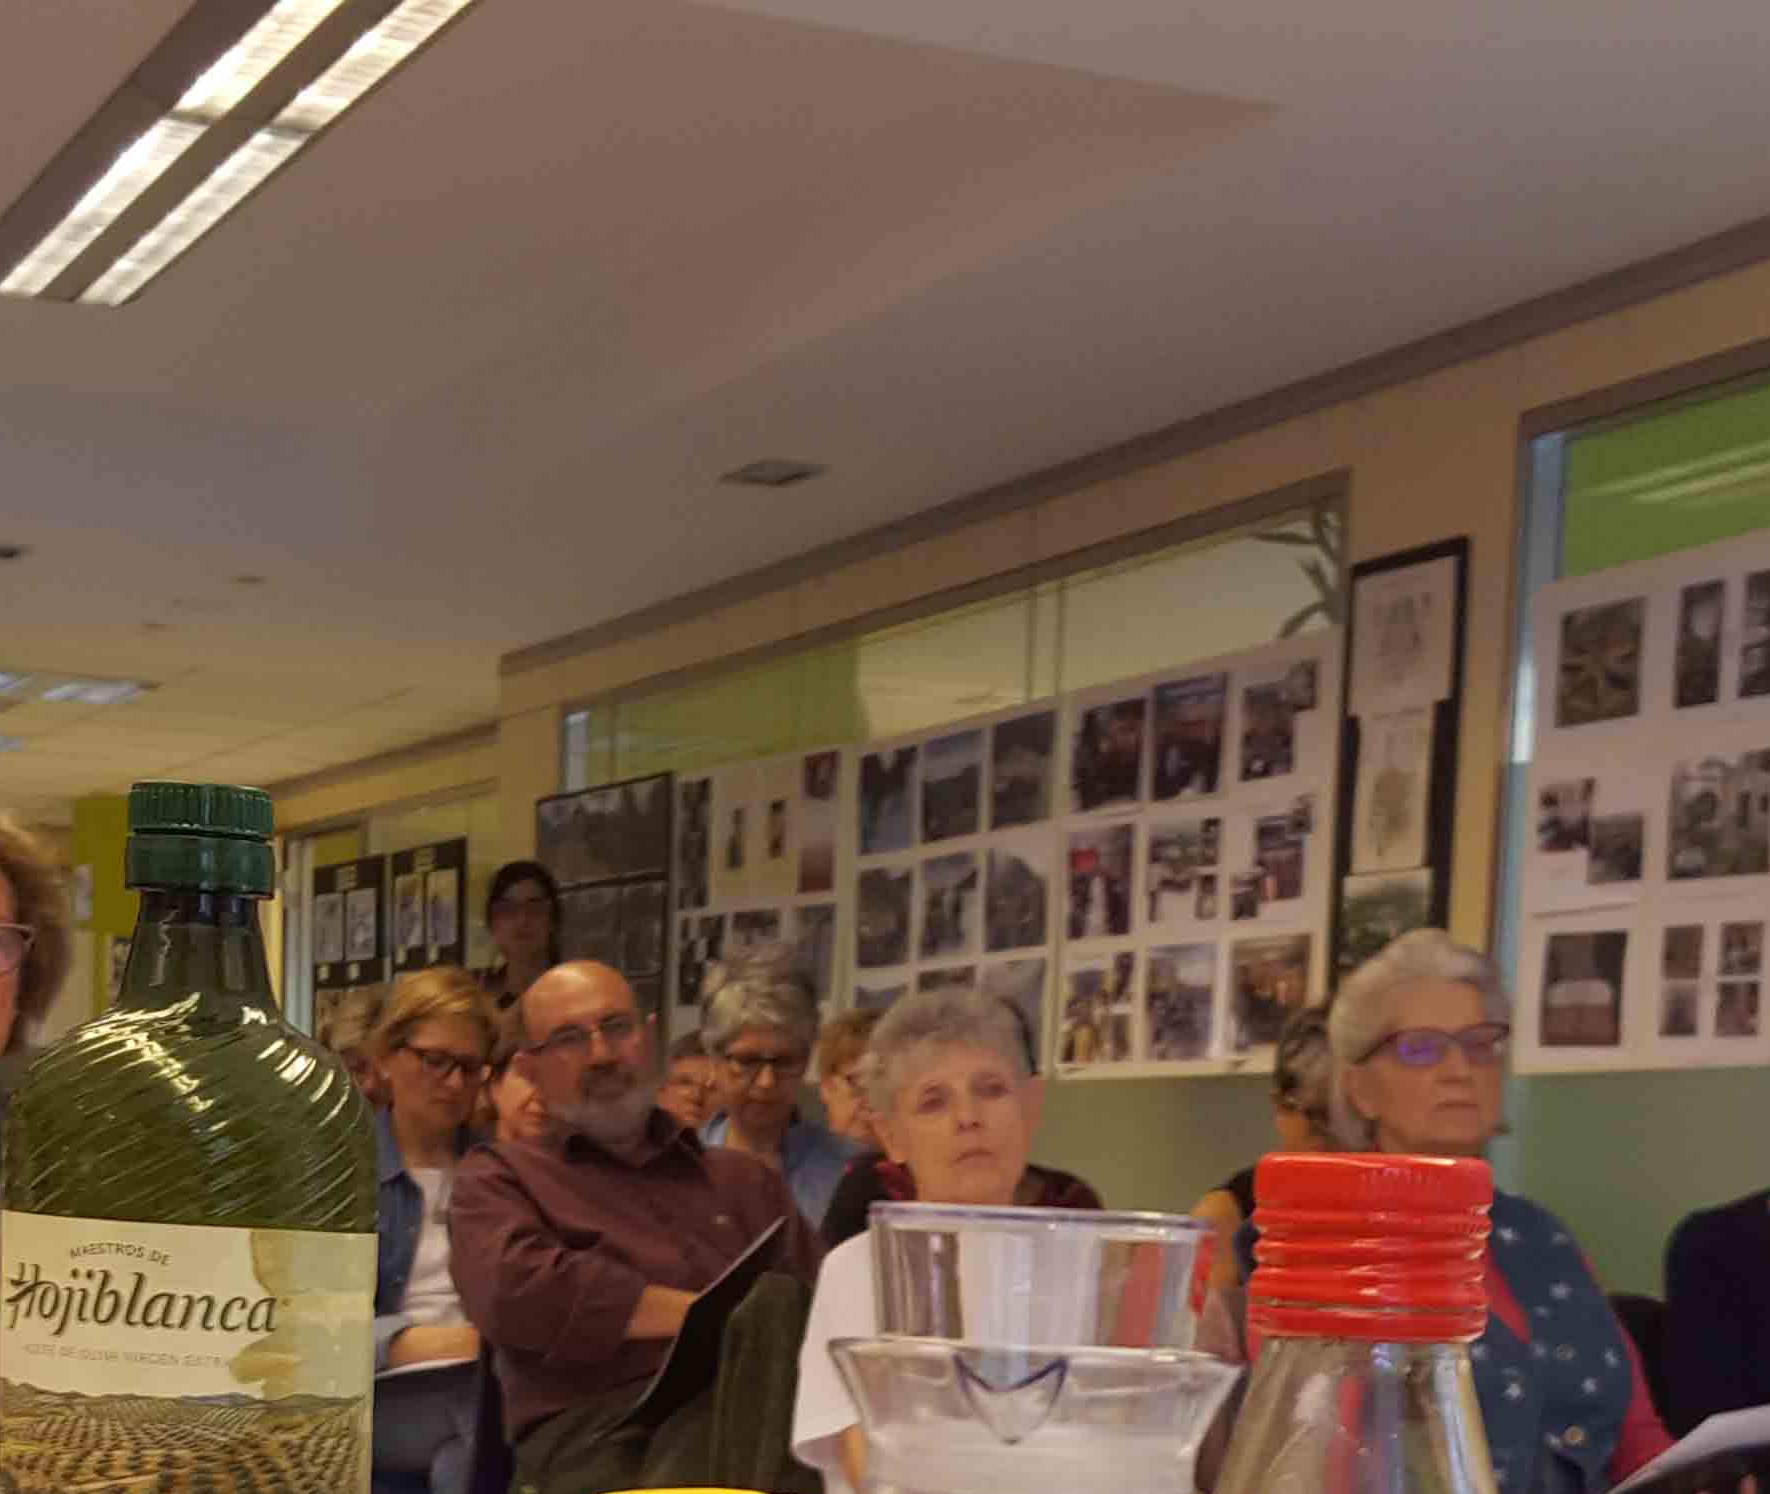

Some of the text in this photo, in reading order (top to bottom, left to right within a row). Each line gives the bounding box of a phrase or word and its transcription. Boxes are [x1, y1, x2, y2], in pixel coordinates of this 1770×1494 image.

[69, 1242, 173, 1266] MAESTROS DE
[5, 1261, 278, 1337] Hojiblanca
